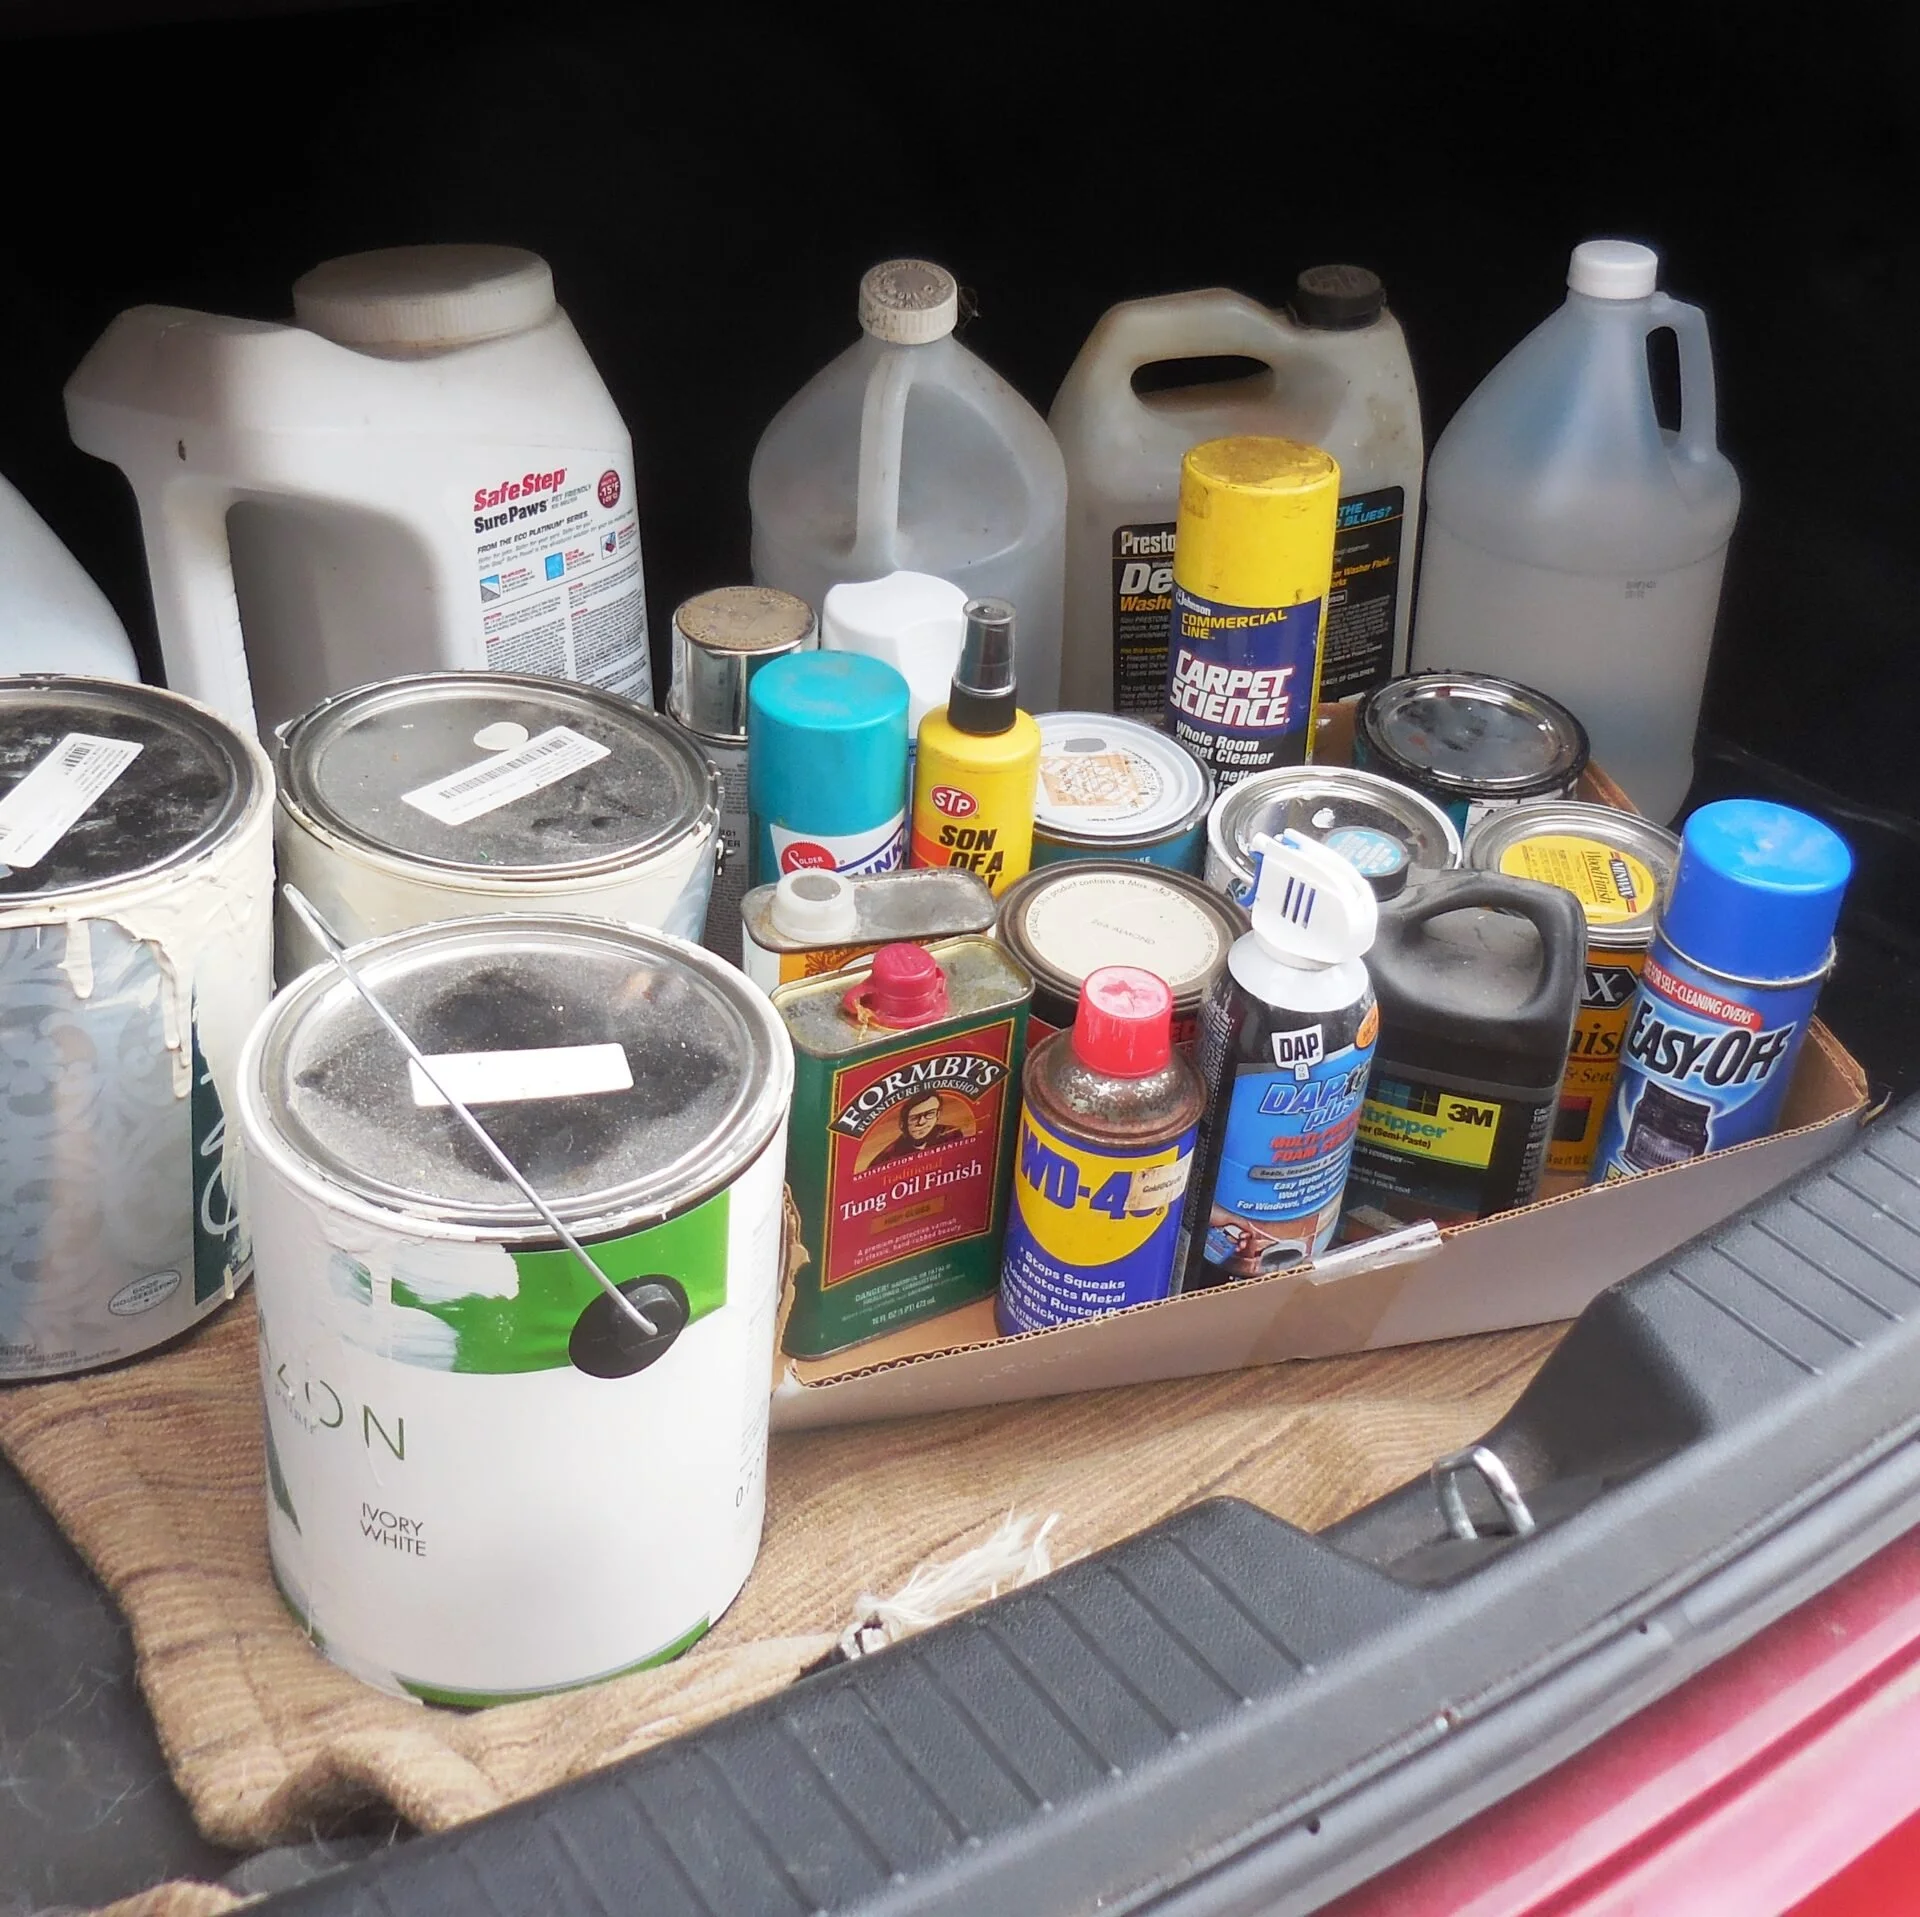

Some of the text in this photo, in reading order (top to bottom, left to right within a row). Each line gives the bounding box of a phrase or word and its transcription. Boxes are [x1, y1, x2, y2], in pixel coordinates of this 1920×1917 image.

[474, 500, 548, 533] SurePaws
[1339, 502, 1364, 516] THE
[1344, 506, 1392, 526] BLUES?
[477, 541, 498, 554] FROM
[499, 537, 512, 547] THE
[514, 532, 527, 542] ECO
[1121, 531, 1176, 555] Presto
[1119, 563, 1173, 594] De
[1120, 595, 1172, 612] Wash
[1181, 609, 1288, 629] COMMERCIAL
[1181, 624, 1210, 640] LINE
[1175, 649, 1293, 699] CARPET
[1176, 720, 1260, 752] Whole Room
[1216, 749, 1274, 765] Cleaner
[935, 790, 971, 814] STP
[939, 824, 998, 852] SON
[949, 851, 1005, 875] OF A
[1661, 974, 1723, 1015] SELF-CLEANING
[1722, 1004, 1755, 1025] OVENS
[1280, 1033, 1320, 1062] DAP
[1628, 1000, 1797, 1086] EASY-OFF
[839, 1056, 1000, 1131] FORMBY'S
[858, 1078, 980, 1132] FURNITURE WORKSHOP
[1365, 1105, 1448, 1138] tripper
[1447, 1103, 1495, 1128] 3M
[1373, 1127, 1432, 1150] (Semi-Paste)
[853, 1136, 976, 1181] SATISFACTION GUARANTEED
[882, 1157, 943, 1186] Traditional
[1021, 1119, 1158, 1220] WD-4
[840, 1160, 982, 1221] Tung Oil Finish
[1273, 1174, 1323, 1191] Easy Water
[1278, 1188, 1305, 1199] Won't
[1237, 1200, 1254, 1209] For
[1255, 1200, 1300, 1211] Windows,
[864, 1239, 894, 1255] premium
[895, 1226, 930, 1243] protective
[1022, 1263, 1126, 1304] Protects Metal
[1025, 1251, 1126, 1290] Stops Squeaks
[855, 1284, 890, 1302] DANGER!
[1009, 1260, 1103, 1317] Loosens Rusted
[1023, 1295, 1063, 1325] Sticky
[362, 1502, 424, 1537] IVORY
[360, 1519, 427, 1557] WHITE
